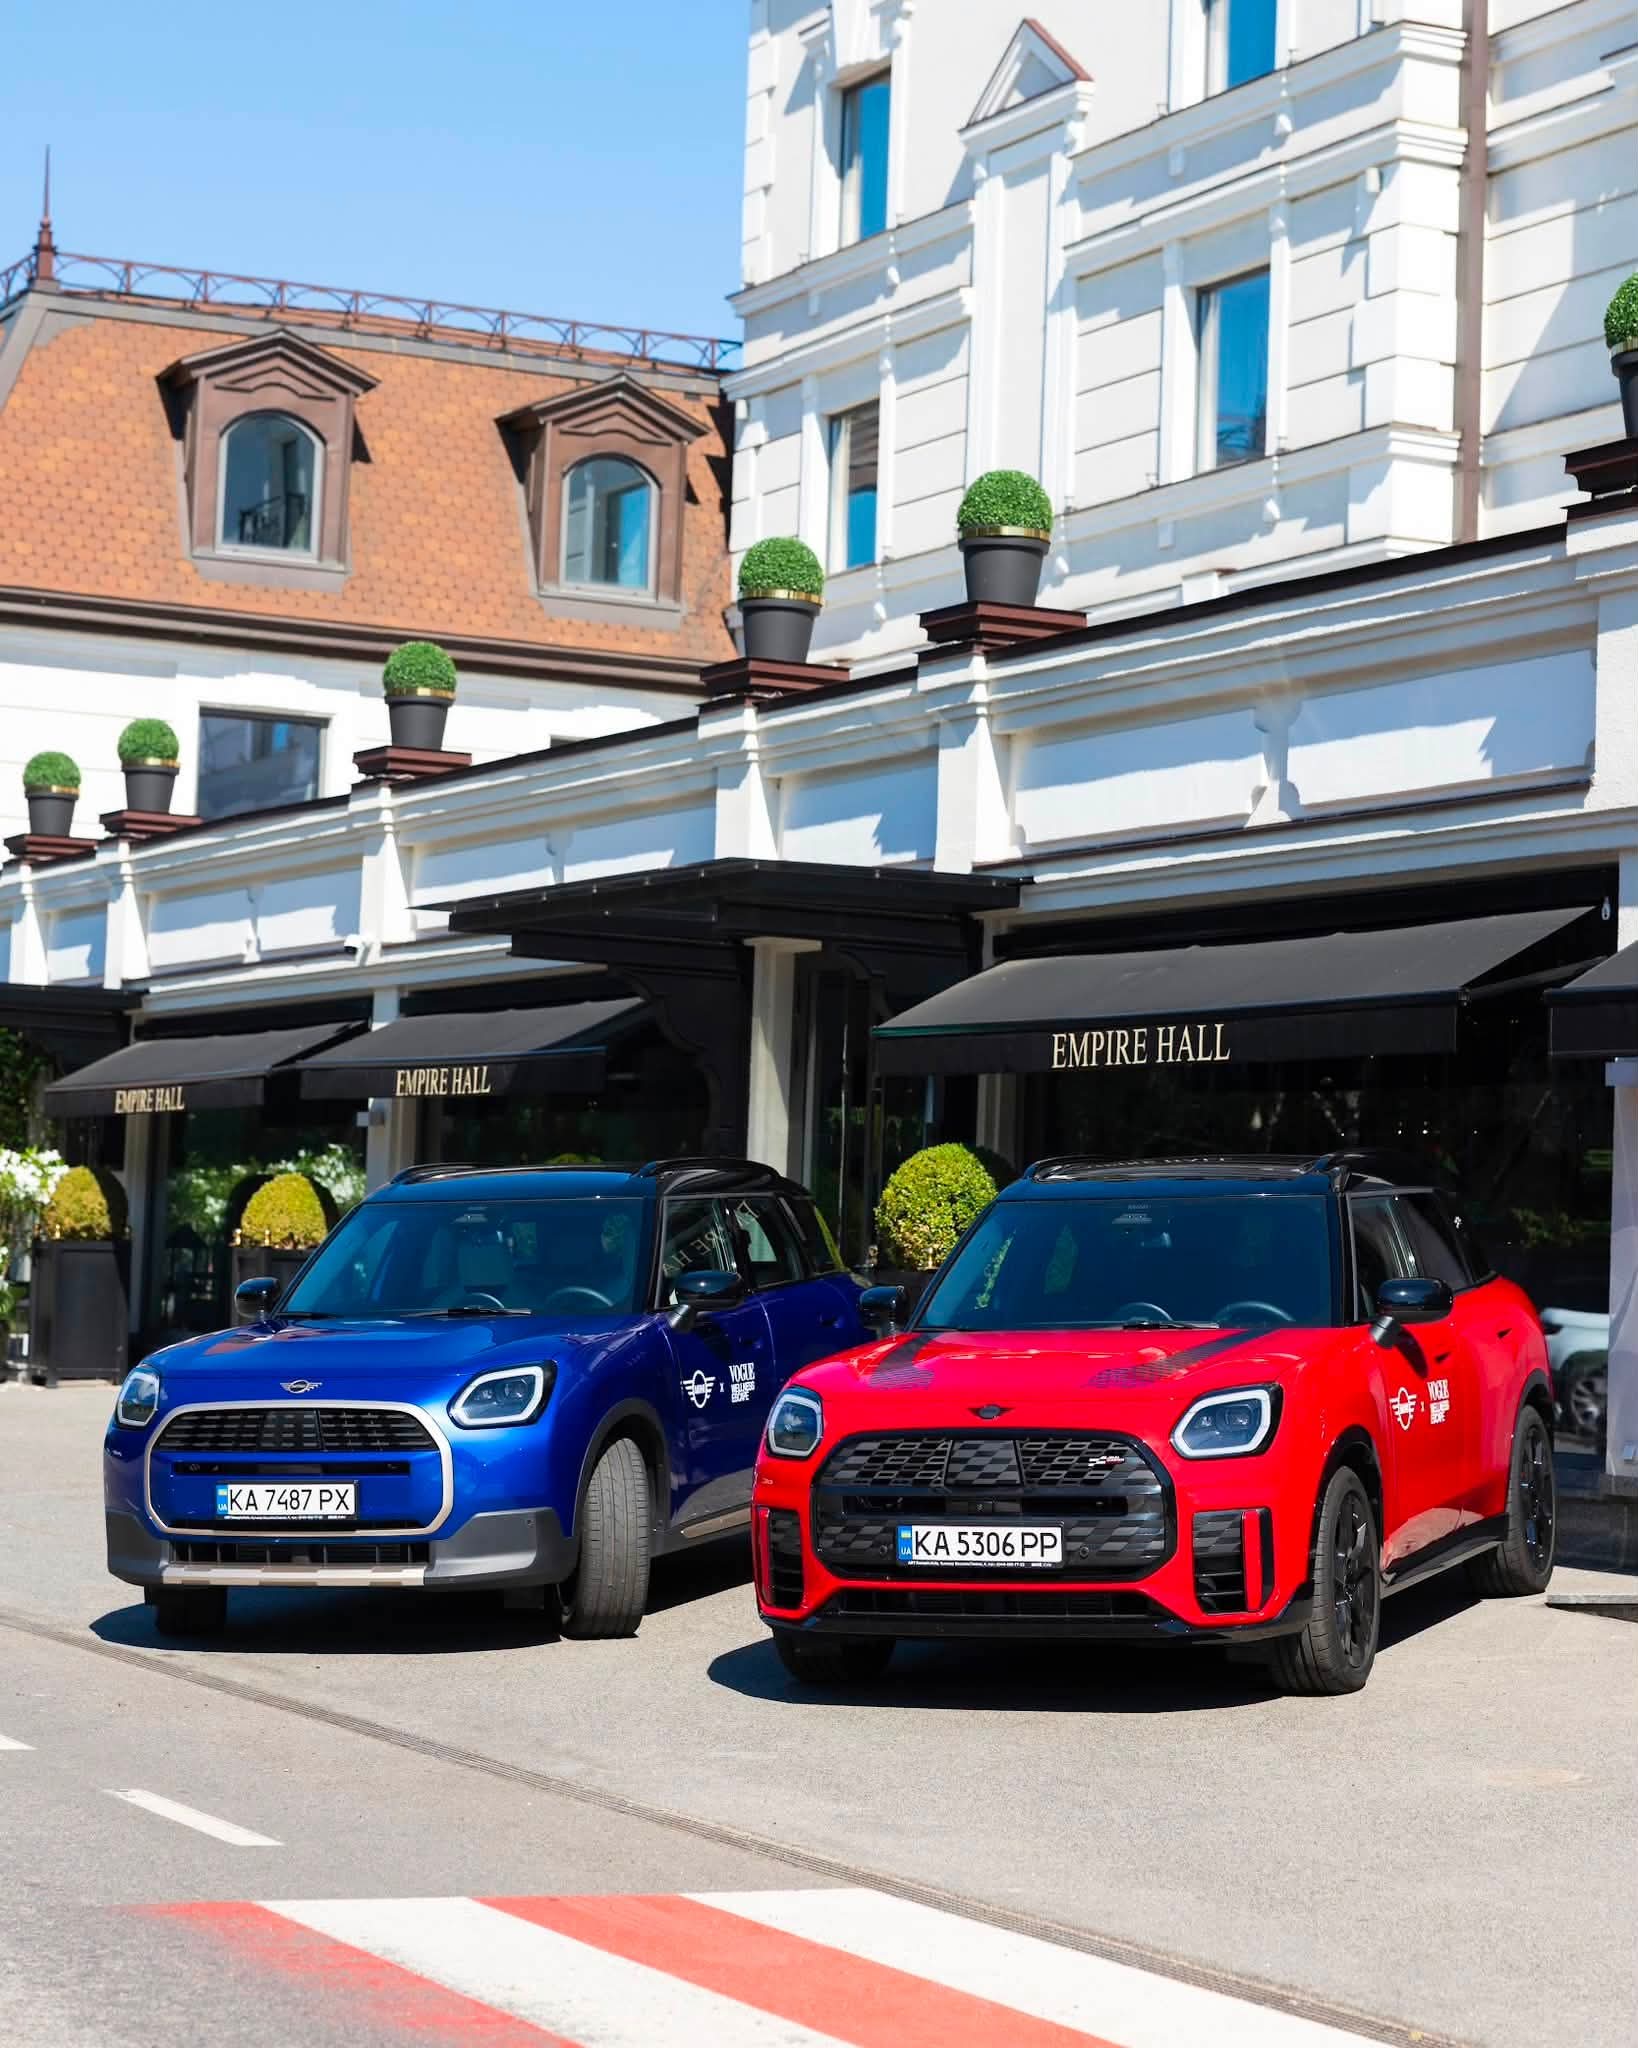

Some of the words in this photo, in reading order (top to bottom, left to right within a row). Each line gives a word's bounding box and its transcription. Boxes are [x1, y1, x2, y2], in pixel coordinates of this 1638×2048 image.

[1051, 1028, 1149, 1069] EMPIRE
[1155, 1023, 1231, 1063] HALL
[395, 1067, 449, 1097] EMPIRE
[451, 1065, 492, 1095] HALL
[114, 1087, 155, 1114] EMPIRE
[154, 1085, 185, 1112] HALL
[728, 1362, 756, 1383] VOGUE
[229, 1489, 258, 1511] KA
[265, 1489, 312, 1511] 7487
[319, 1489, 350, 1511] PX
[900, 1547, 912, 1556] UA
[915, 1531, 950, 1556] KA
[957, 1532, 1015, 1557] 5306
[1021, 1532, 1058, 1557] PP
